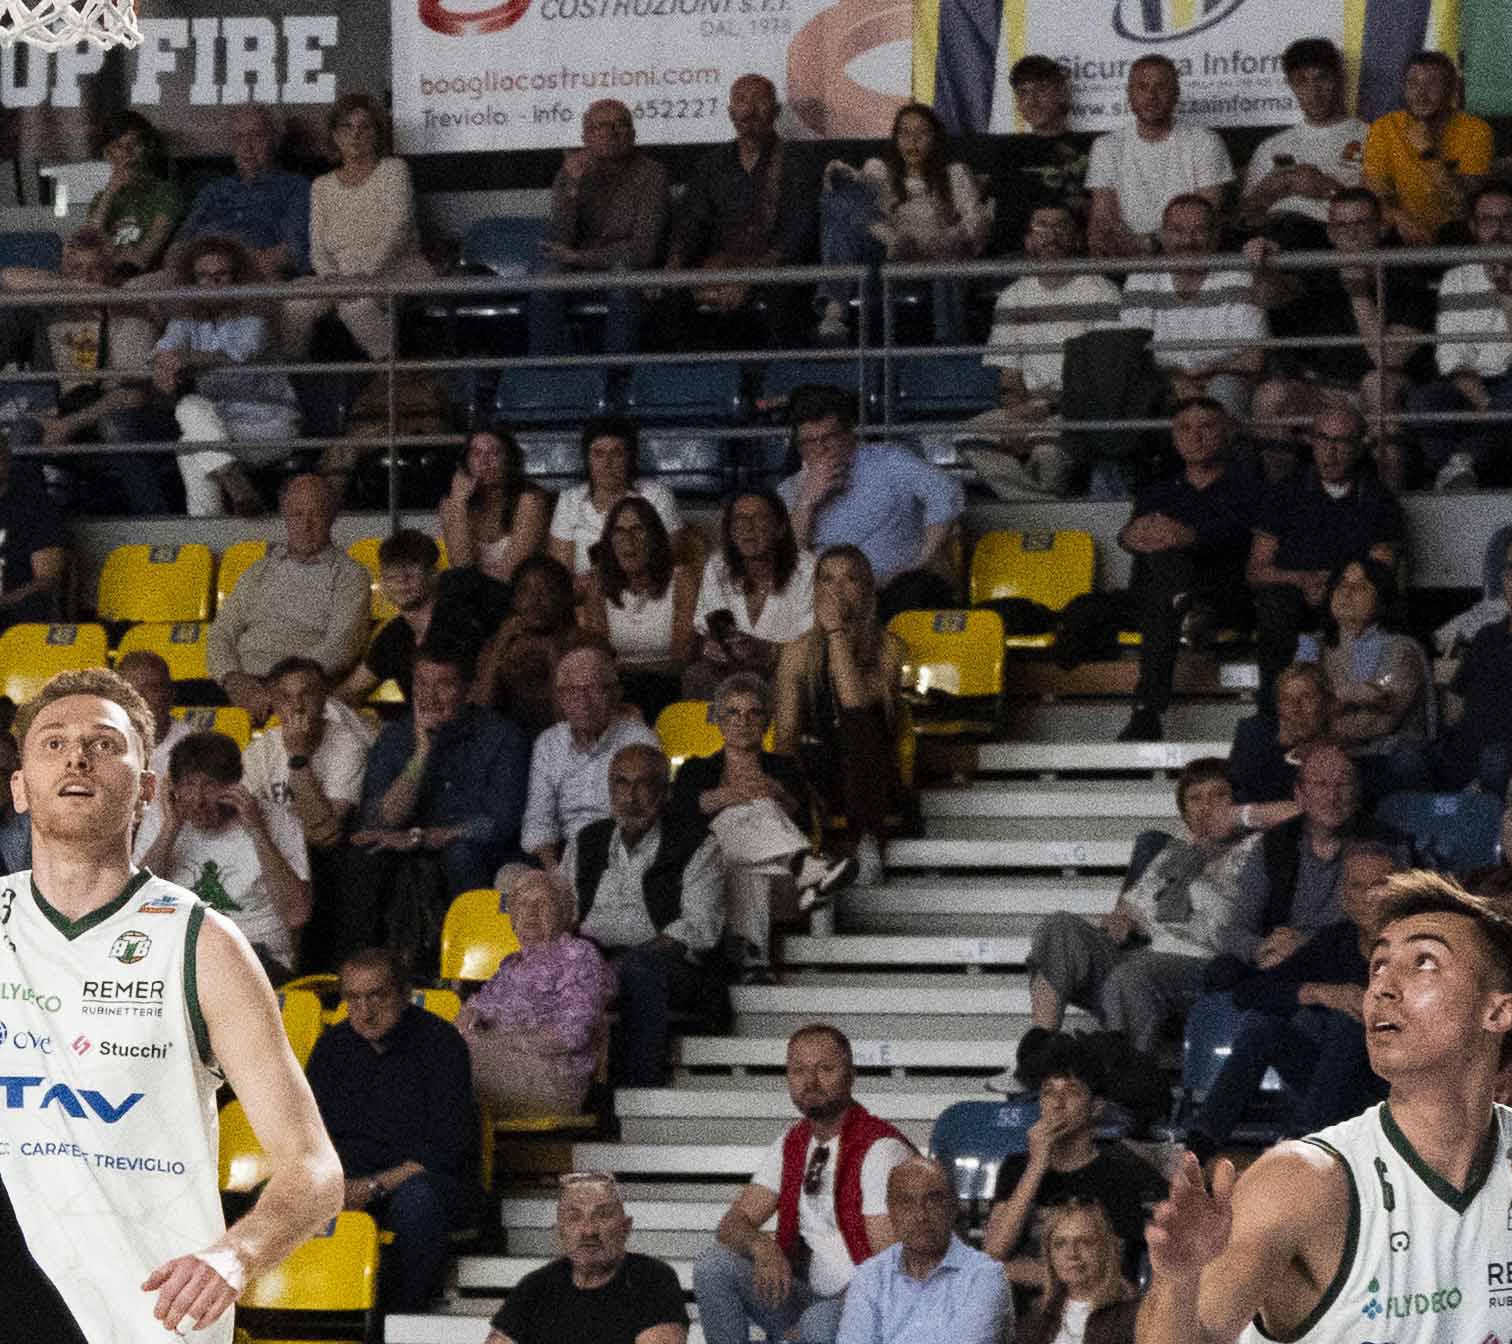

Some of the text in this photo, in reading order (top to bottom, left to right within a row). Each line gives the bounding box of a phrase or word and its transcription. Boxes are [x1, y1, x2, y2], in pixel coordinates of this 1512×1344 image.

[129, 15, 339, 106] FIRE
[82, 979, 165, 1000] REMER
[81, 1006, 164, 1017] RUBINETTERIE
[100, 1040, 168, 1059] Stucchi
[94, 1153, 185, 1175] TREVIGLIO
